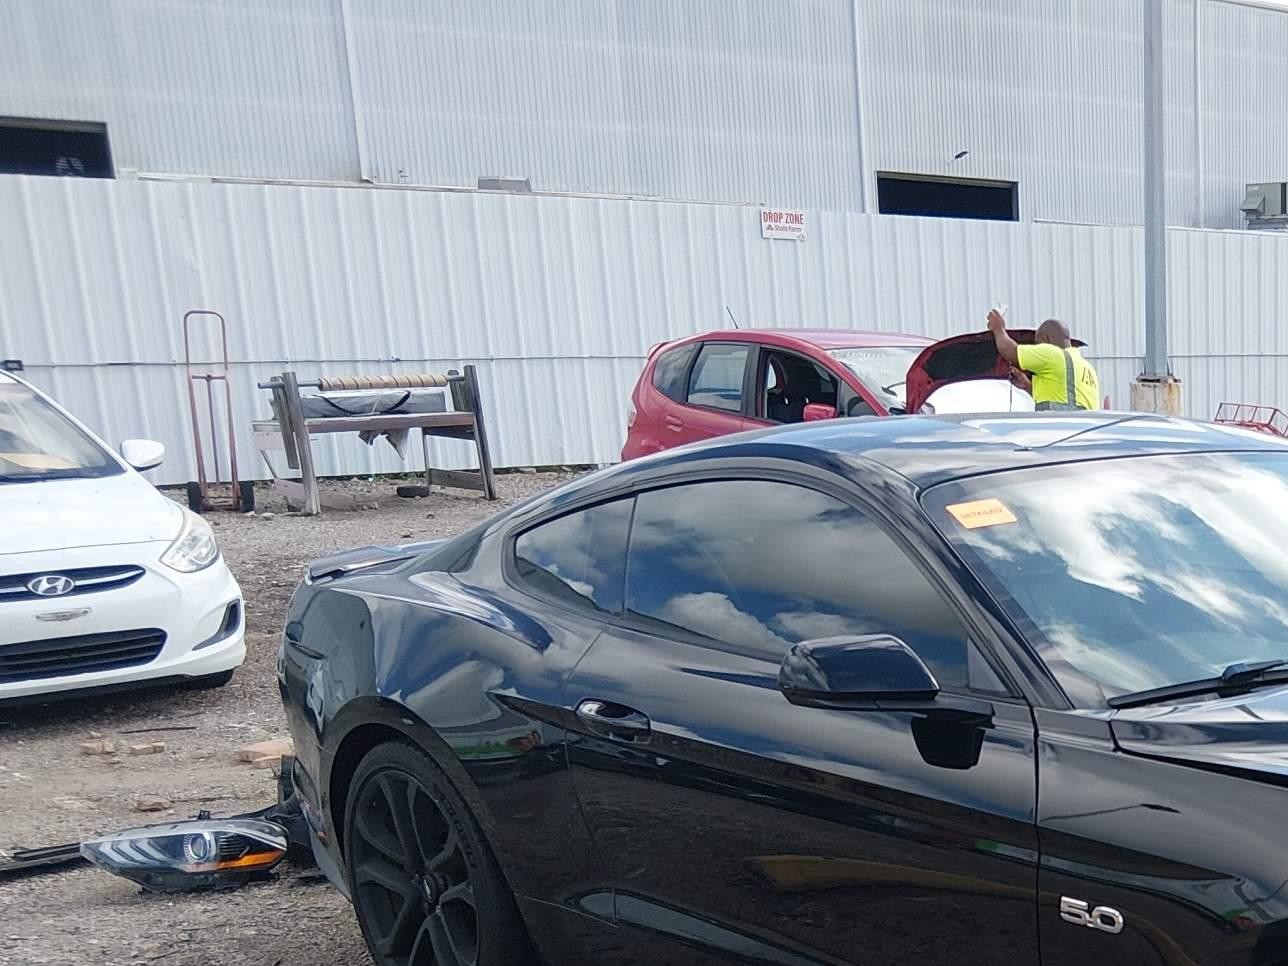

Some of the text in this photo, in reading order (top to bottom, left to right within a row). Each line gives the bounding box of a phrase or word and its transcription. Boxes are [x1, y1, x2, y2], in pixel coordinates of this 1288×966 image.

[763, 211, 805, 224] DROP ZONE
[1060, 895, 1124, 934] 5.0
